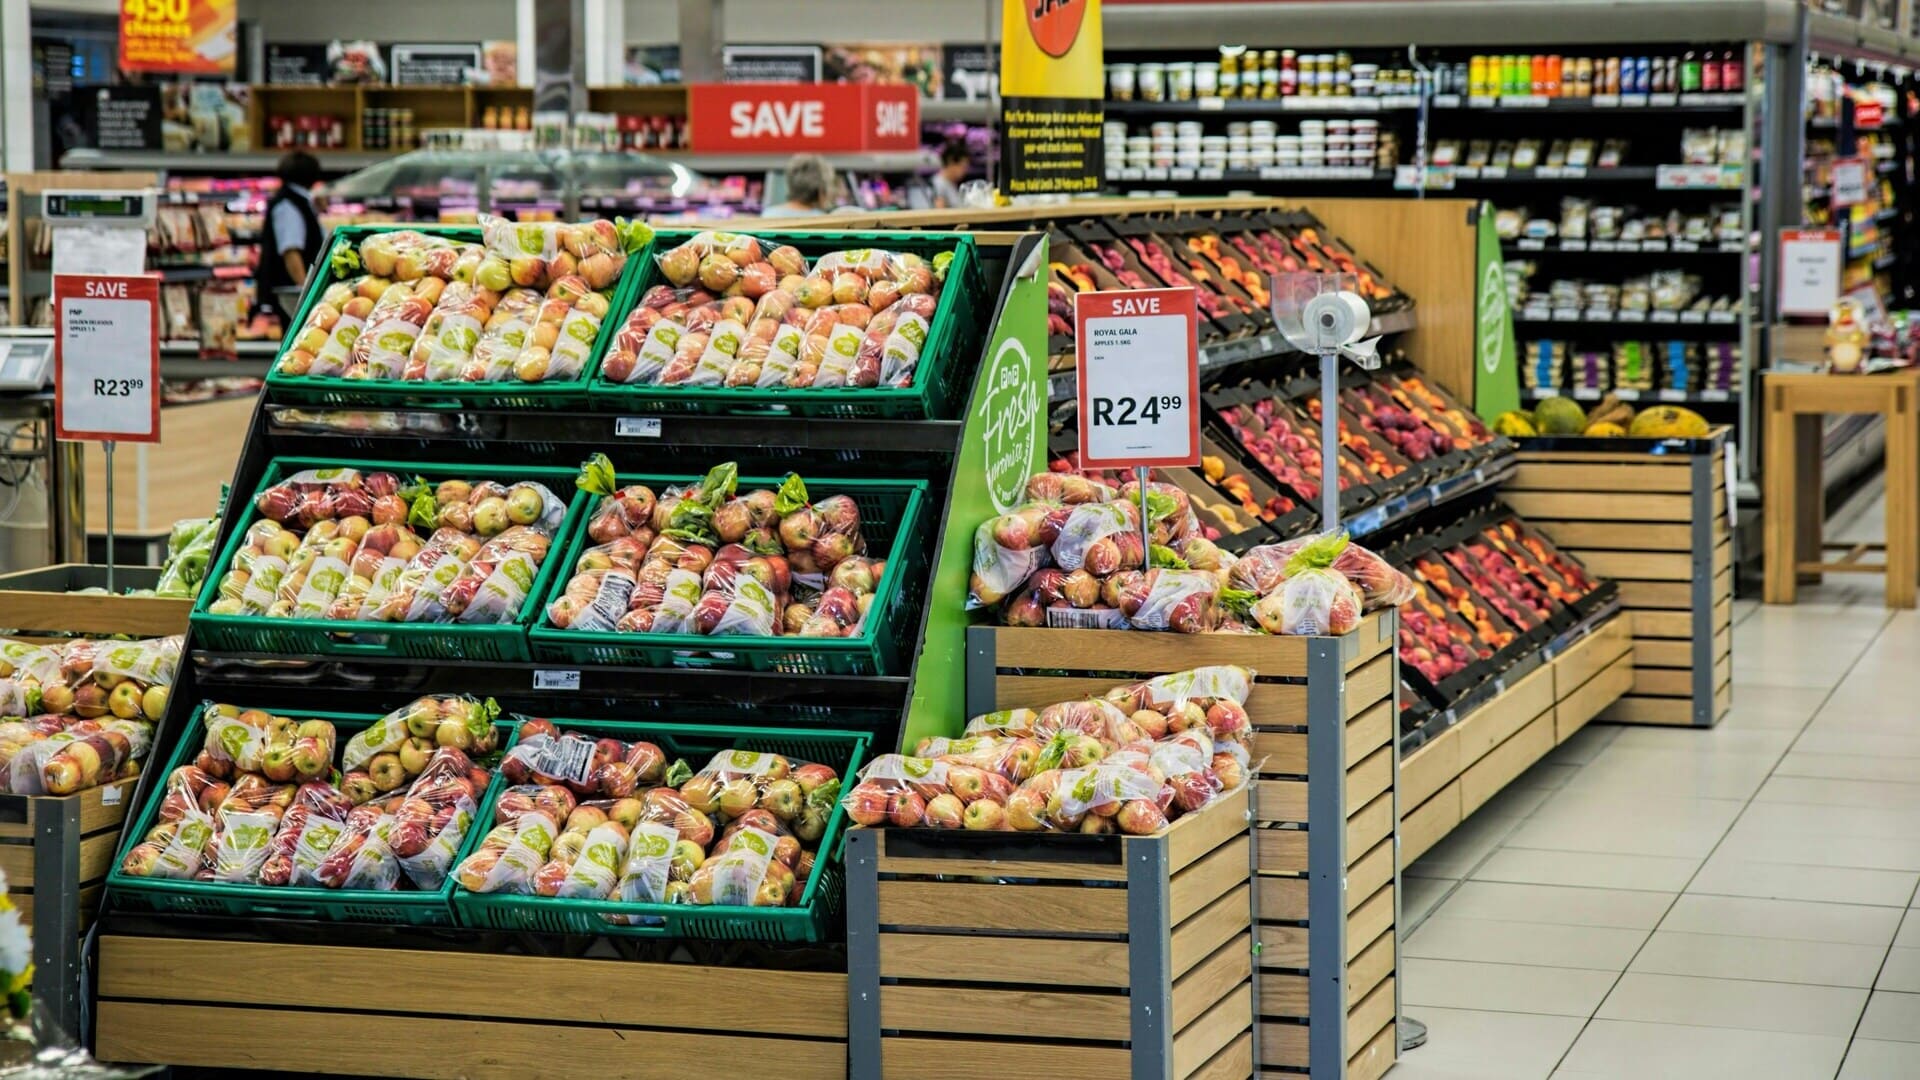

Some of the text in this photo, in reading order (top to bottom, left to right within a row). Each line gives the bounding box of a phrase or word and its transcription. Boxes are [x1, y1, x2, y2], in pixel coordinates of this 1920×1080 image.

[730, 101, 825, 138] SAVE
[875, 101, 909, 137] SAVE
[85, 281, 128, 298] SAVE
[1112, 298, 1160, 315] SAVE
[1119, 328, 1137, 336] GALA
[979, 356, 1041, 454] Fresh
[1093, 396, 1182, 426] R2499
